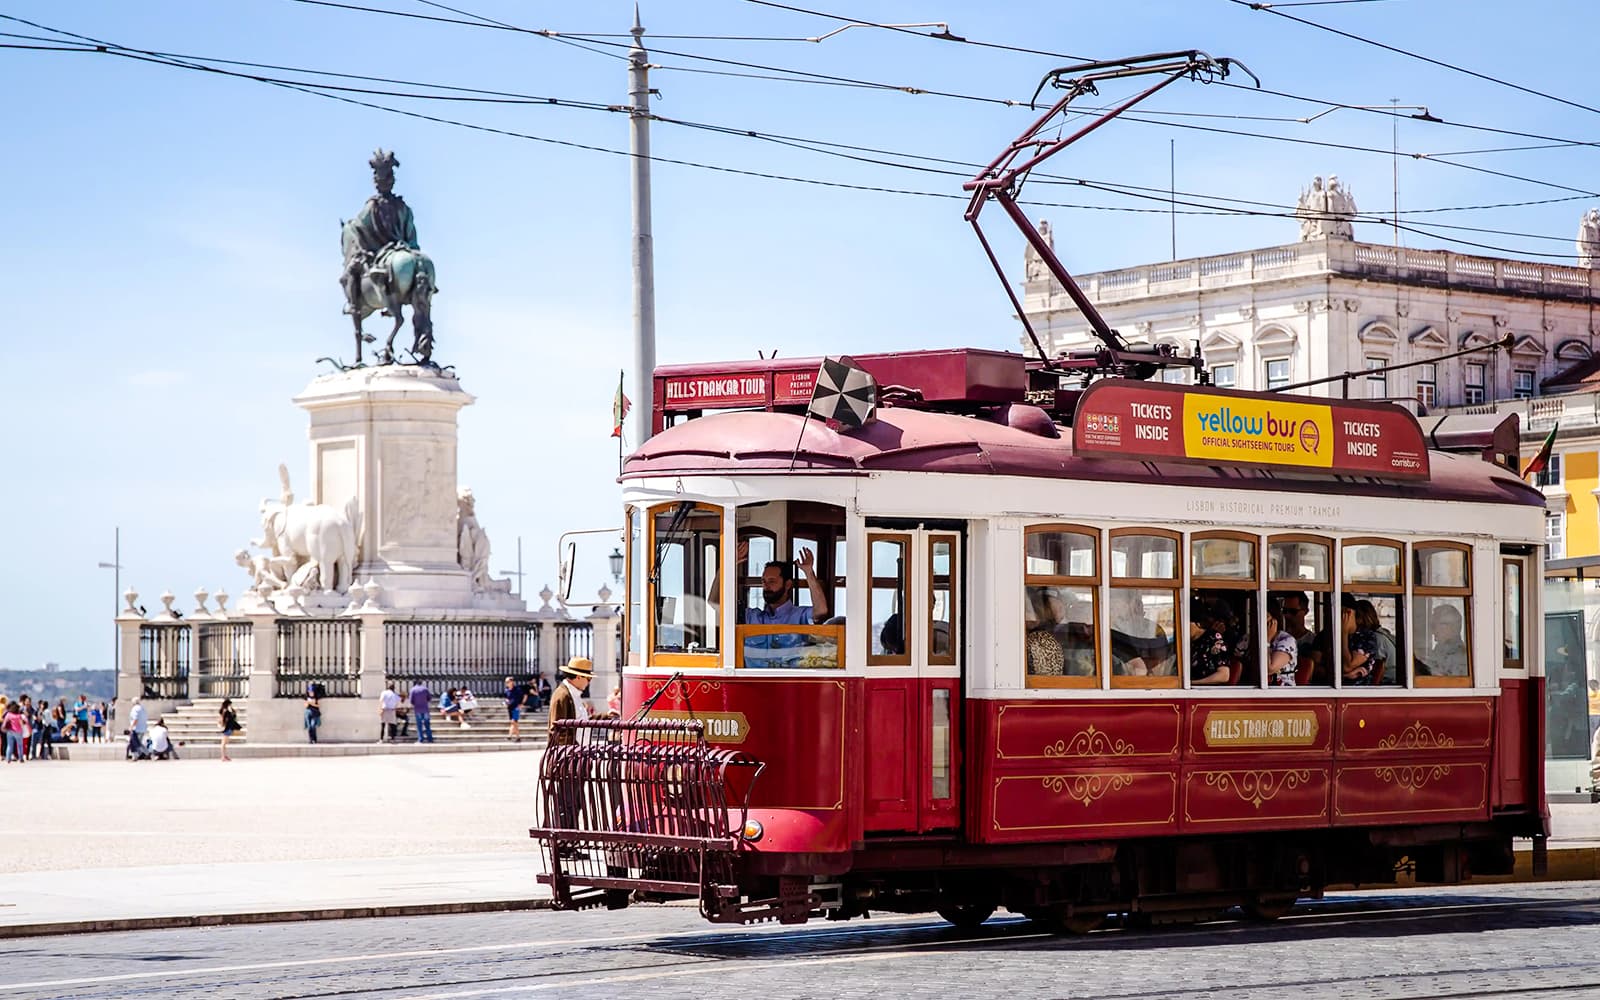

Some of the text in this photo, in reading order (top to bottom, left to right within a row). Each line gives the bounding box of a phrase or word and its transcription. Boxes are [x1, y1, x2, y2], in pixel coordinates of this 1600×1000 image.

[667, 377, 766, 398] HILLS TRAMCAR TOUR
[1130, 403, 1172, 420] TICKETS
[1135, 424, 1169, 441] INSIDE
[1266, 411, 1297, 438] bus
[1343, 421, 1380, 437] TICKETS
[1202, 437, 1295, 453] OFFICIAL SIGHTSEEING TOURS
[1347, 442, 1378, 457] INSIDE
[1186, 500, 1215, 512] LISBON
[1220, 501, 1265, 515] HISTORICAL
[1270, 503, 1304, 516] PREMIUM
[707, 719, 739, 736] TOUR
[1211, 719, 1312, 739] HILLS TRAMCAR TOUR
